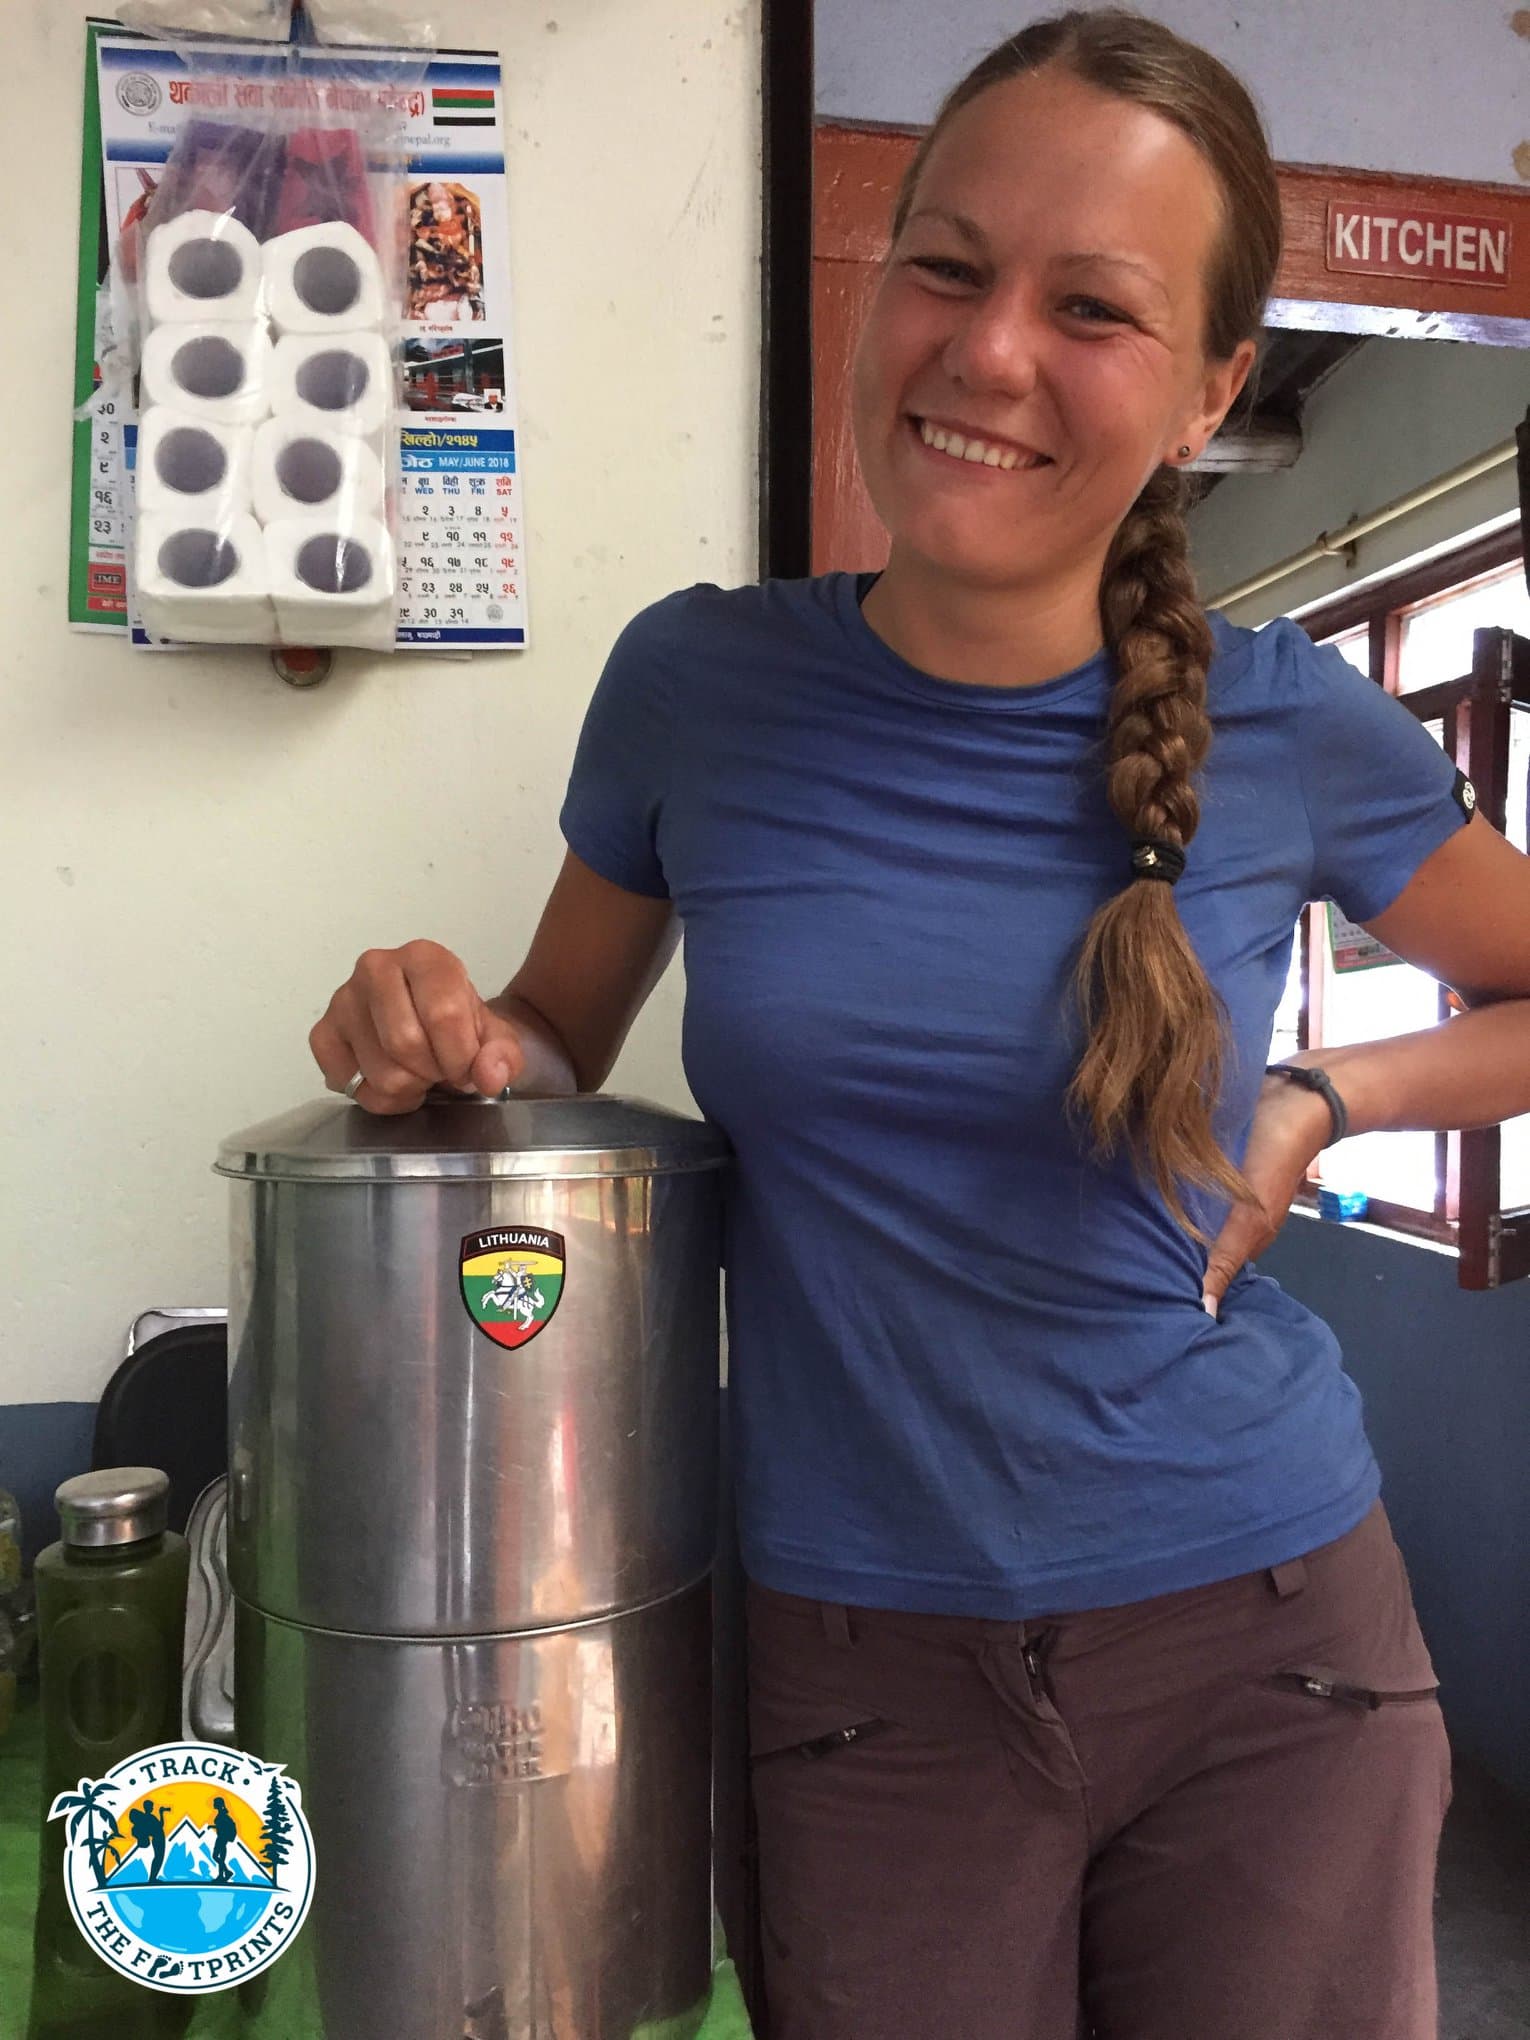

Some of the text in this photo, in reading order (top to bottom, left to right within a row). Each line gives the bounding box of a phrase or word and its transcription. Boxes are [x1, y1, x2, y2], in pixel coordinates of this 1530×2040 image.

[1335, 213, 1505, 274] KITCHEN
[438, 456, 486, 468] MAY/JUNE
[488, 457, 510, 468] 2018
[96, 574, 121, 585] IME
[402, 582, 408, 592] २
[478, 1233, 550, 1249] LITHUANIA
